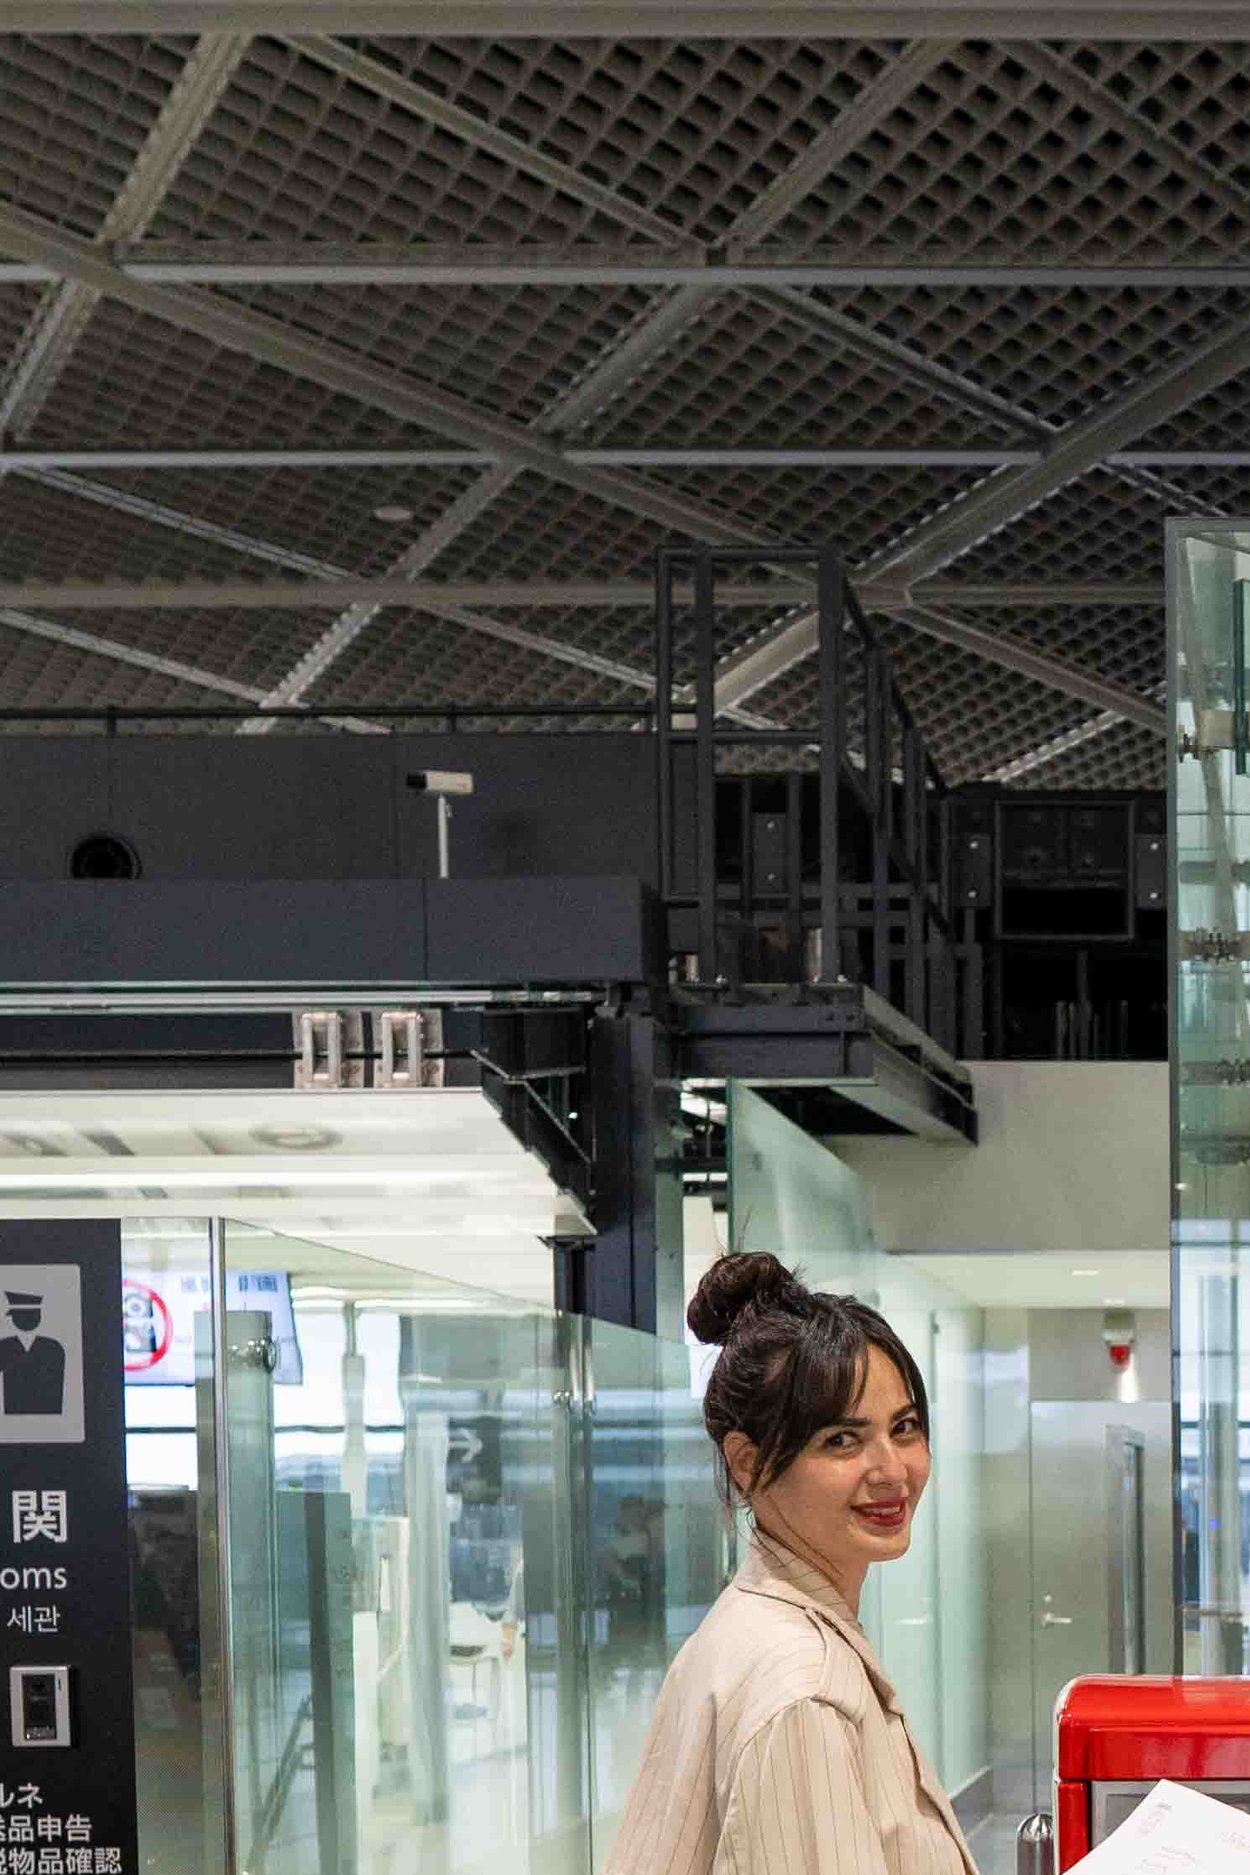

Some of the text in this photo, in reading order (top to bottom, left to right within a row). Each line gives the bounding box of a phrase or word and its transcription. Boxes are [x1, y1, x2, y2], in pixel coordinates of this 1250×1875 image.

[12, 1490, 67, 1543] 関
[0, 1567, 67, 1590] oms
[6, 1605, 61, 1633] 세관
[0, 1813, 92, 1842] 品申告
[0, 1847, 122, 1875] 物品確認
